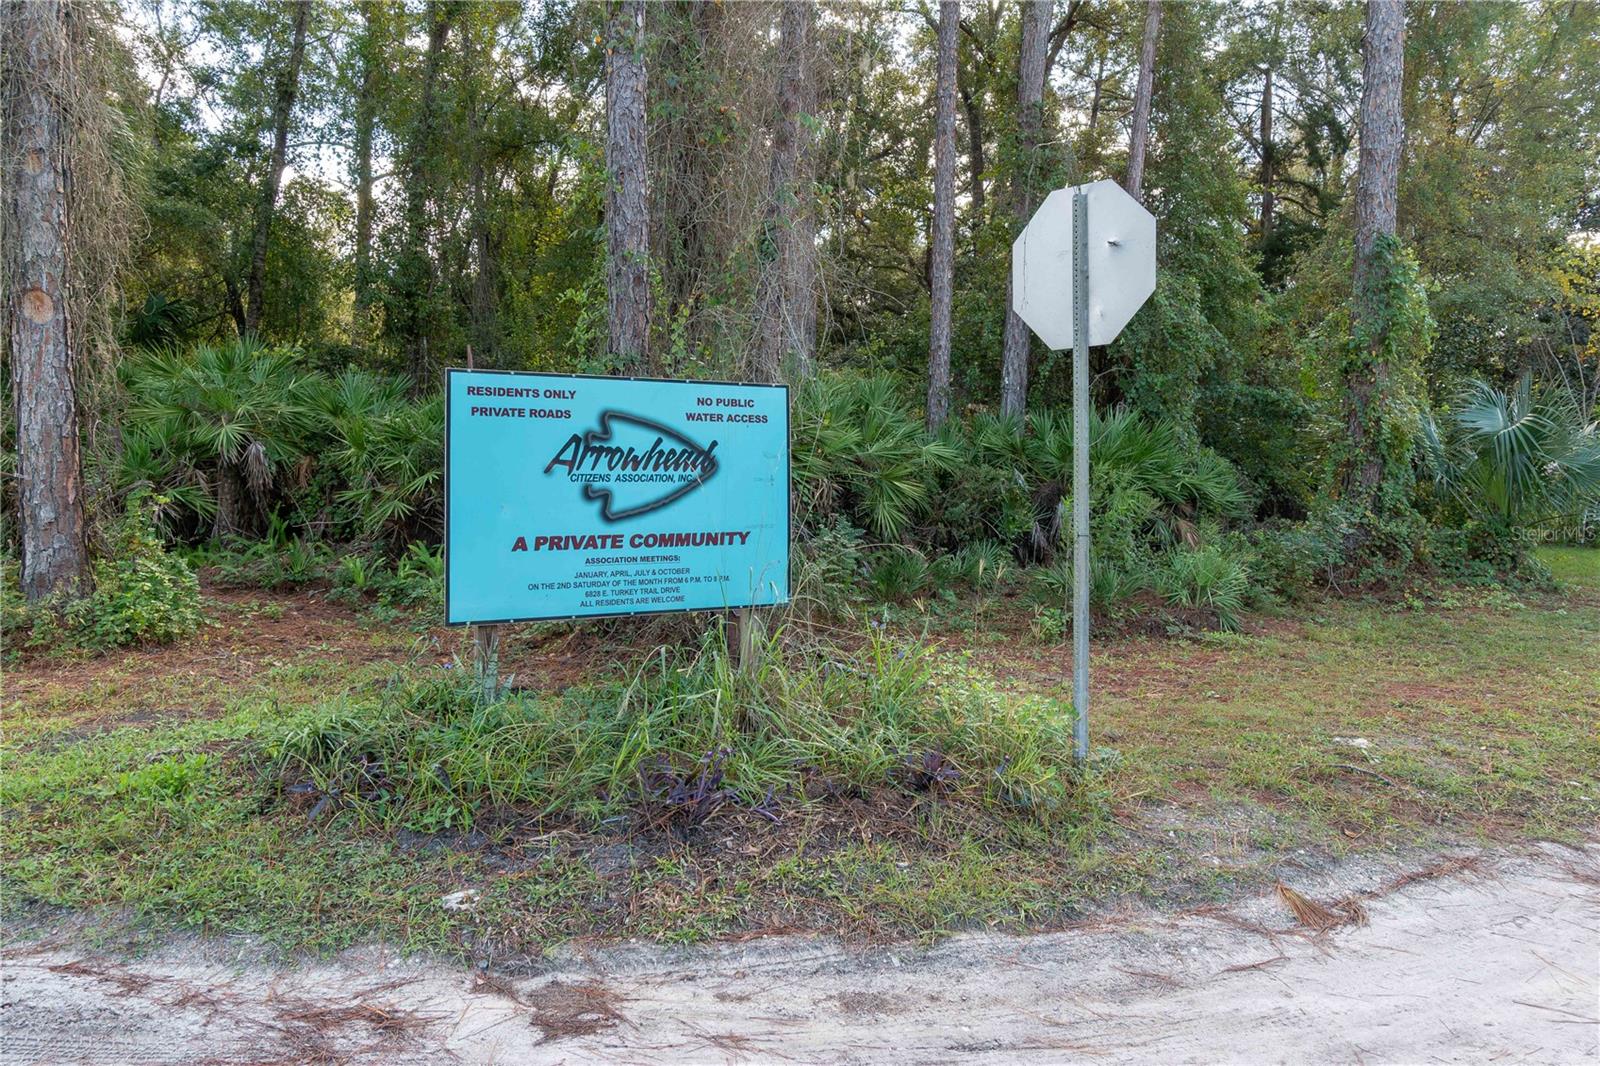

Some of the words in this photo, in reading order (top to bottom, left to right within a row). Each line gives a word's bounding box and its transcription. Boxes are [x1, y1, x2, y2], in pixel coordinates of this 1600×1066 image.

[467, 386, 540, 398] RESIDENTS
[543, 389, 576, 399] ONLY
[697, 398, 713, 406] NO
[716, 398, 755, 408] PUBLIC
[471, 406, 526, 417] PRIVATE
[529, 408, 572, 419] ROADS
[685, 412, 724, 422] WATER
[726, 414, 768, 424] ACCESS
[543, 433, 719, 475] Arrowhead
[570, 474, 611, 483] CITIZENS
[614, 474, 676, 484] ASSOCIATION,
[511, 536, 528, 552] A
[534, 534, 625, 551] PRIVATE
[629, 531, 751, 549] COMMUNITY
[585, 556, 638, 565] ASSOCIATION
[640, 554, 681, 563] MEETINGS:
[574, 571, 608, 579] JANUARY,
[610, 570, 632, 578] APRIL,
[634, 569, 650, 577] JULY
[658, 567, 690, 576] OCTOBER
[528, 583, 539, 591] ON
[573, 579, 610, 589] SATURDAY
[612, 579, 622, 587] OF
[624, 579, 637, 587] THE
[638, 578, 662, 586] MONTH
[664, 577, 684, 585] FROM
[611, 588, 638, 597] TURKEY
[661, 586, 680, 595] DRIVE
[580, 600, 593, 608] ALL
[595, 598, 634, 607] RESIDENTS
[635, 597, 649, 605] ARE
[651, 595, 685, 604] WELCOME
